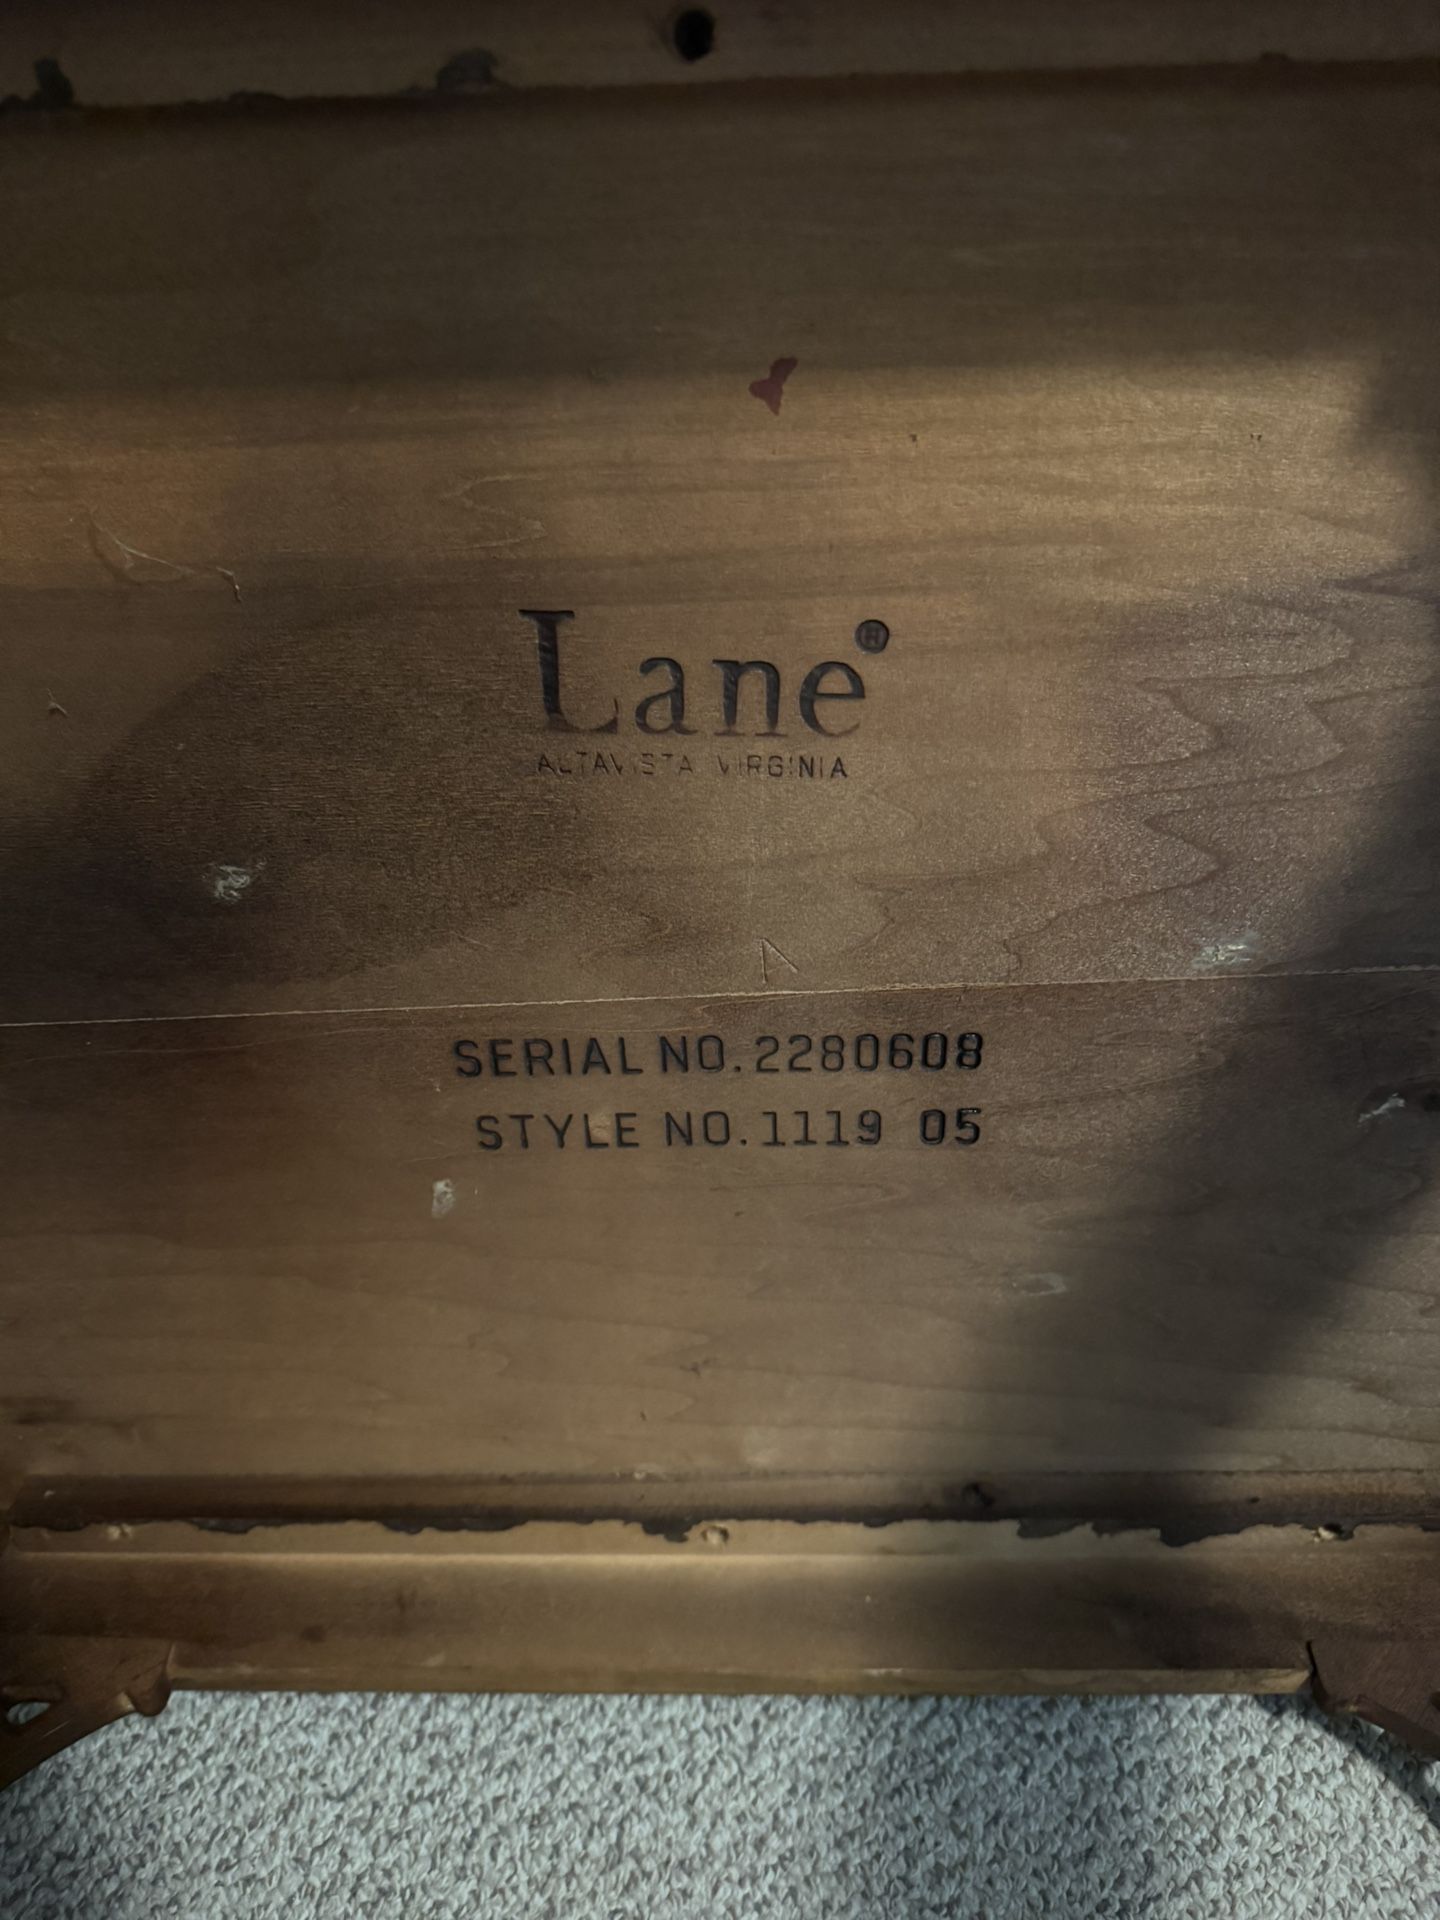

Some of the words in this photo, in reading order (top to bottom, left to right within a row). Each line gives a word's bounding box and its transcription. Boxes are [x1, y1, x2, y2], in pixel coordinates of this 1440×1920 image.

[718, 753, 849, 781] VIRGINIA
[453, 1037, 644, 1078] SERIAL
[475, 1111, 640, 1151] STYLE
[919, 1106, 983, 1147] 05
